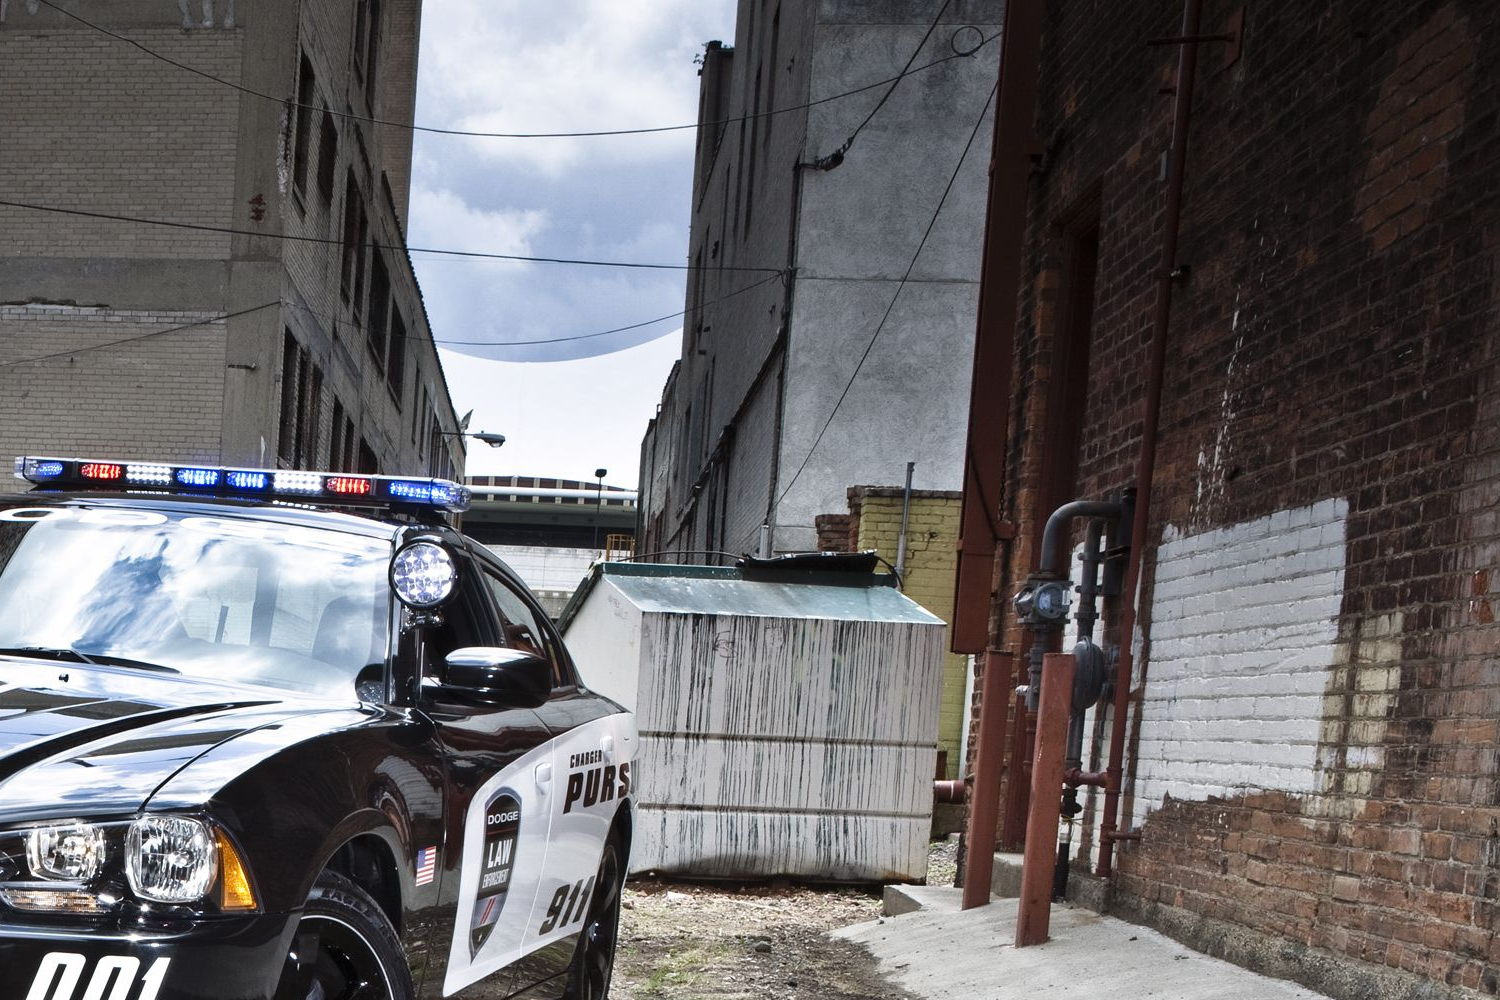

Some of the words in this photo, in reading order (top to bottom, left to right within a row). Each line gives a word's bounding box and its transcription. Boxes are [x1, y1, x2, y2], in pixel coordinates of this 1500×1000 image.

[569, 749, 603, 769] CHARGER
[487, 810, 519, 825] DODGE
[487, 838, 513, 869] LAW
[538, 874, 596, 937] 911
